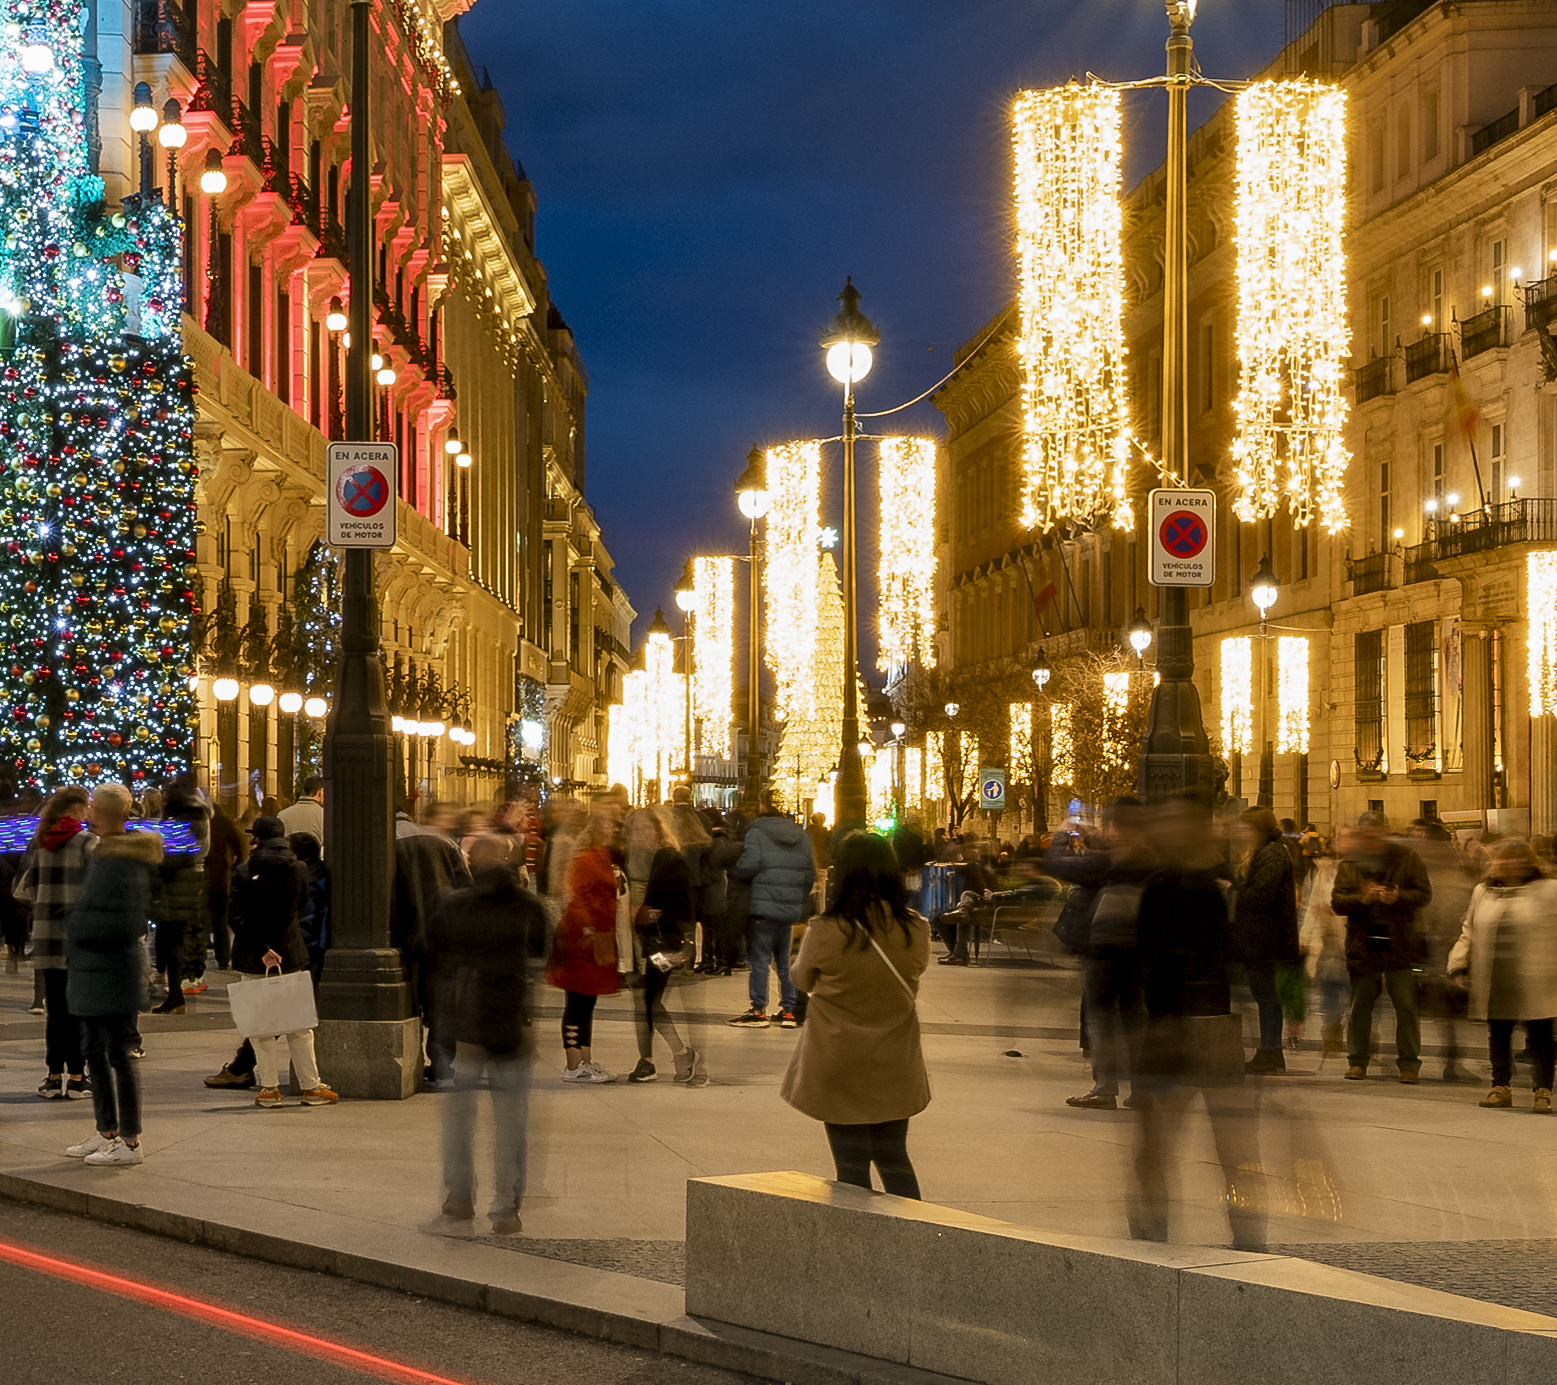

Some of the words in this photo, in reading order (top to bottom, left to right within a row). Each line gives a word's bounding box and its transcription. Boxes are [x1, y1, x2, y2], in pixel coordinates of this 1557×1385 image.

[335, 451, 350, 461] EN
[353, 451, 389, 461] ACERA
[1158, 498, 1172, 506] EN
[1175, 498, 1208, 507] ACERA
[339, 521, 385, 530] VEHÍCULOS
[340, 531, 352, 539] DE
[354, 531, 383, 539] MOTOR
[1162, 562, 1204, 570] VEHÍCULOS
